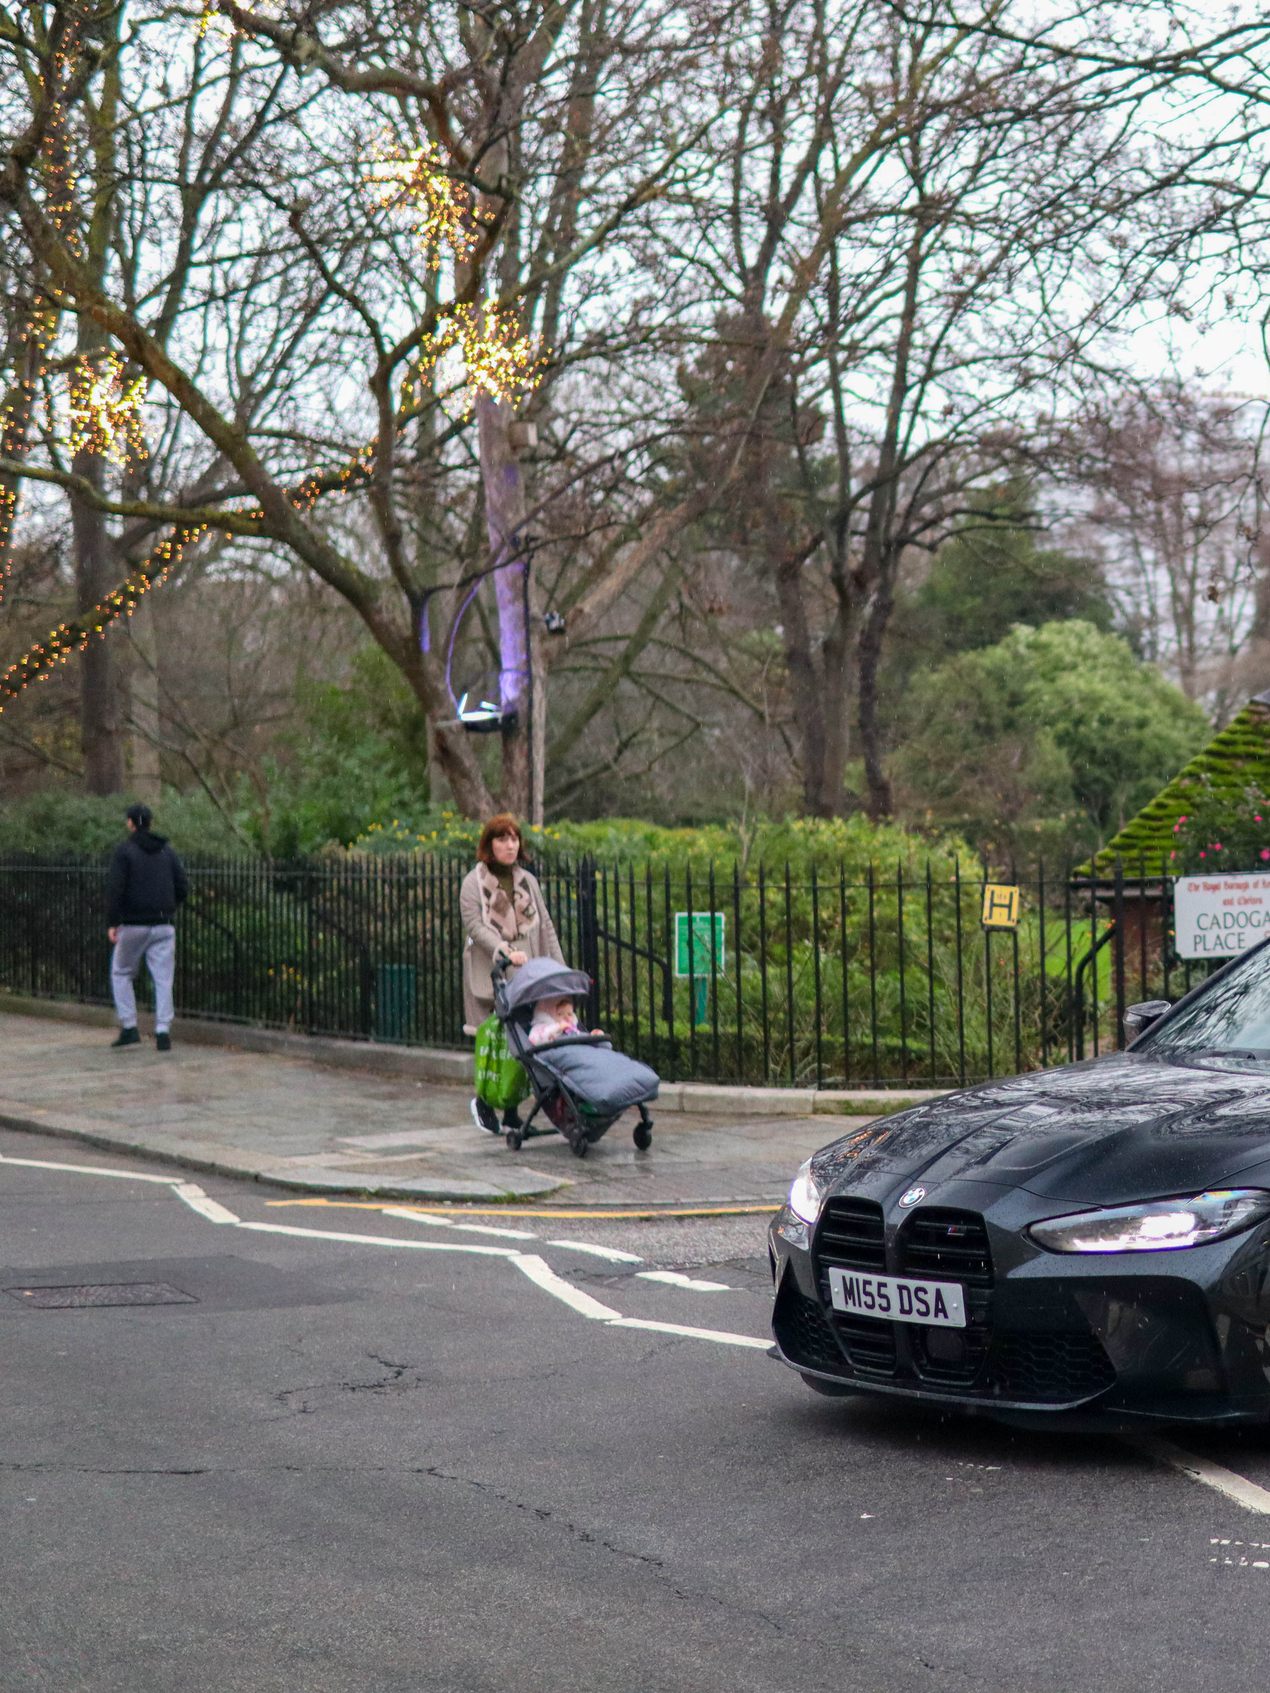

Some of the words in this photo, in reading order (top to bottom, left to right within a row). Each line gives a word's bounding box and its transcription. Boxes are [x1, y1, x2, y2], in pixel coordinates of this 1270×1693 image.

[1188, 882, 1200, 892] The
[1194, 932, 1246, 952] PLACE
[896, 1283, 949, 1320] DSA
